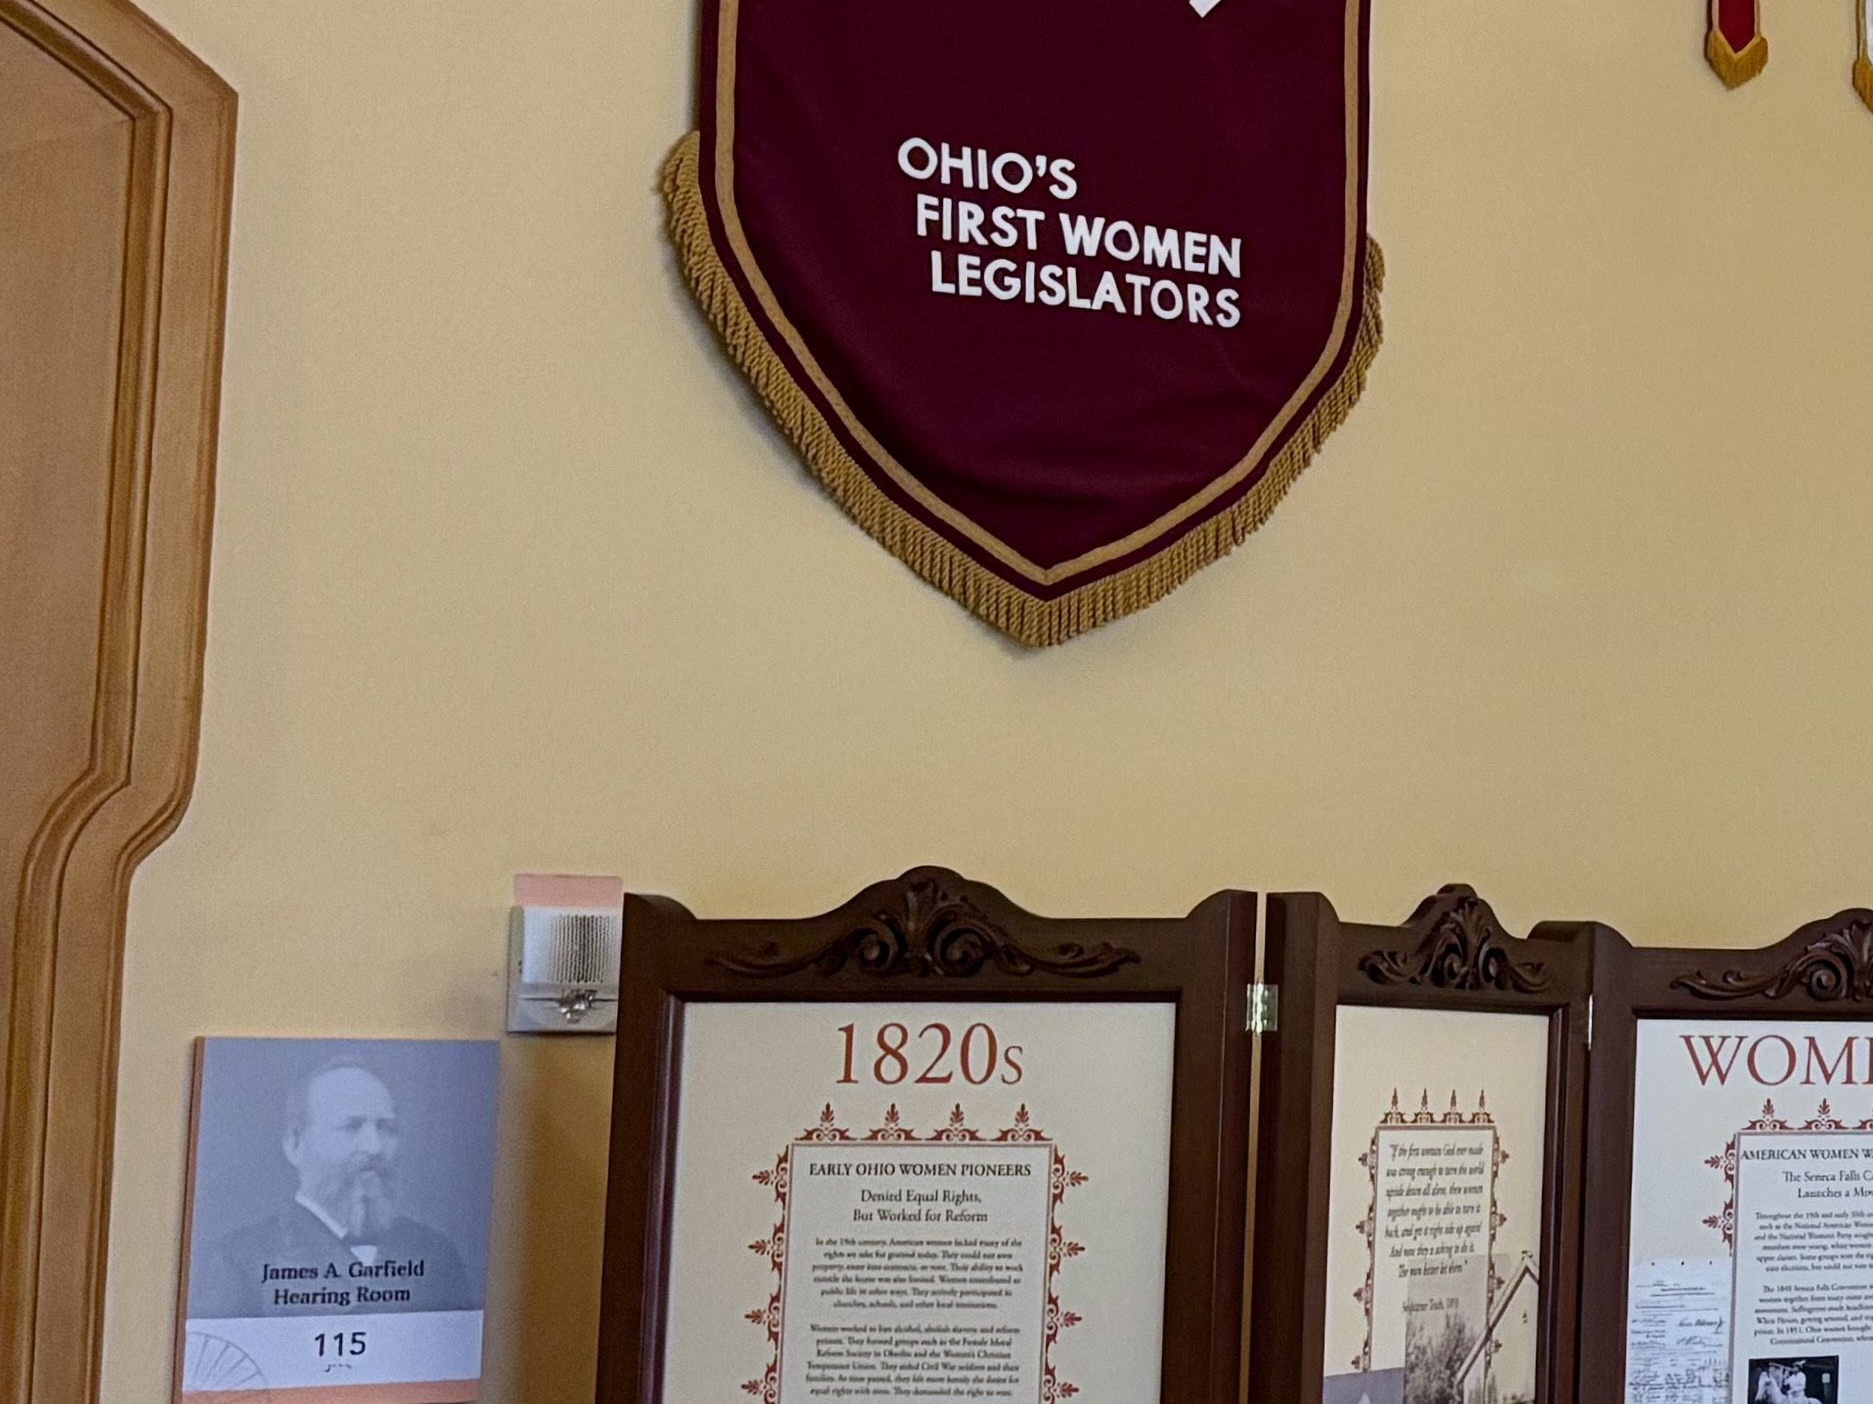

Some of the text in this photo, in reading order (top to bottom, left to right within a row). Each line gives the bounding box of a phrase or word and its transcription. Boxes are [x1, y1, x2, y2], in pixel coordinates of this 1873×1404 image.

[915, 194, 1242, 280] FIRST WOMEN
[930, 250, 1242, 329] LEGISLATORS
[836, 1022, 1024, 1085] 1820s
[1740, 1149, 1806, 1160] AMERICAN
[1810, 1148, 1859, 1159] WOMEN
[809, 1163, 1032, 1176] EARLY OHIO WOMEN PIONEERS
[1782, 1171, 1801, 1182] The
[1803, 1171, 1836, 1182] Seneca
[1839, 1170, 1860, 1181] Falls
[861, 1189, 902, 1202] Denied
[906, 1189, 938, 1206] Equal
[853, 1209, 988, 1222] But Worked for Reform
[262, 1263, 318, 1283] James
[348, 1259, 425, 1278] Garfield
[273, 1286, 411, 1306] Hearing Room
[314, 1332, 367, 1357] 115
